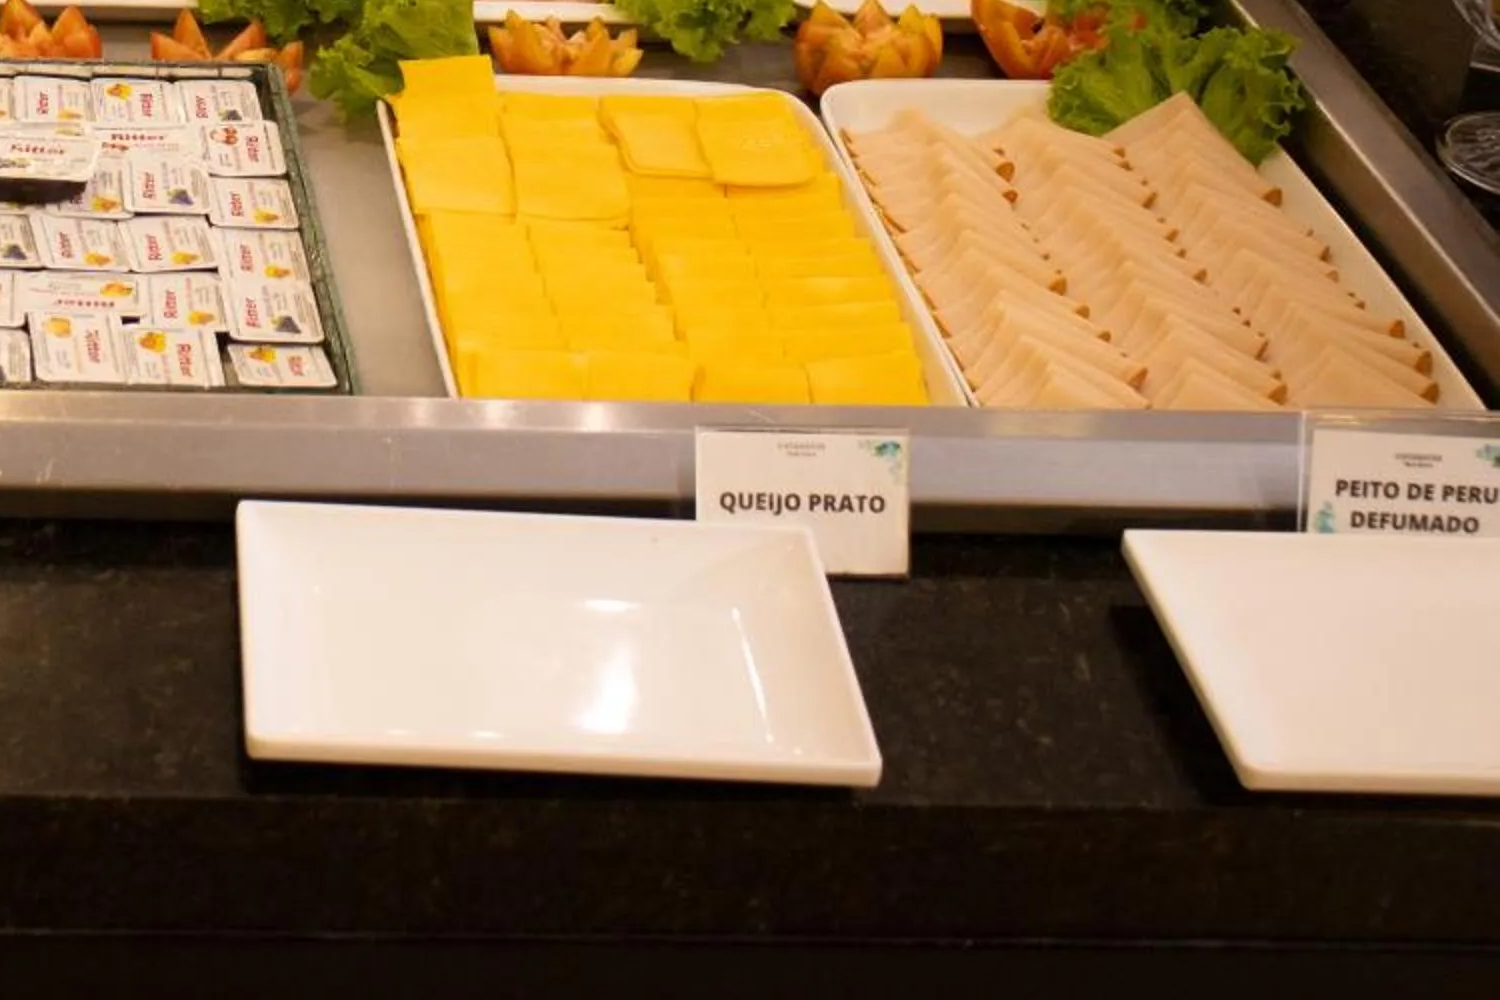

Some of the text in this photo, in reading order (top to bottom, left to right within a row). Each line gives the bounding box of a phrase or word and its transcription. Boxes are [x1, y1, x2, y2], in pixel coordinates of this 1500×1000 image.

[719, 491, 886, 516] QUEIJO PRATO
[1336, 479, 1498, 504] PEITO DE PERU
[1351, 510, 1479, 533] DEFUMADO
